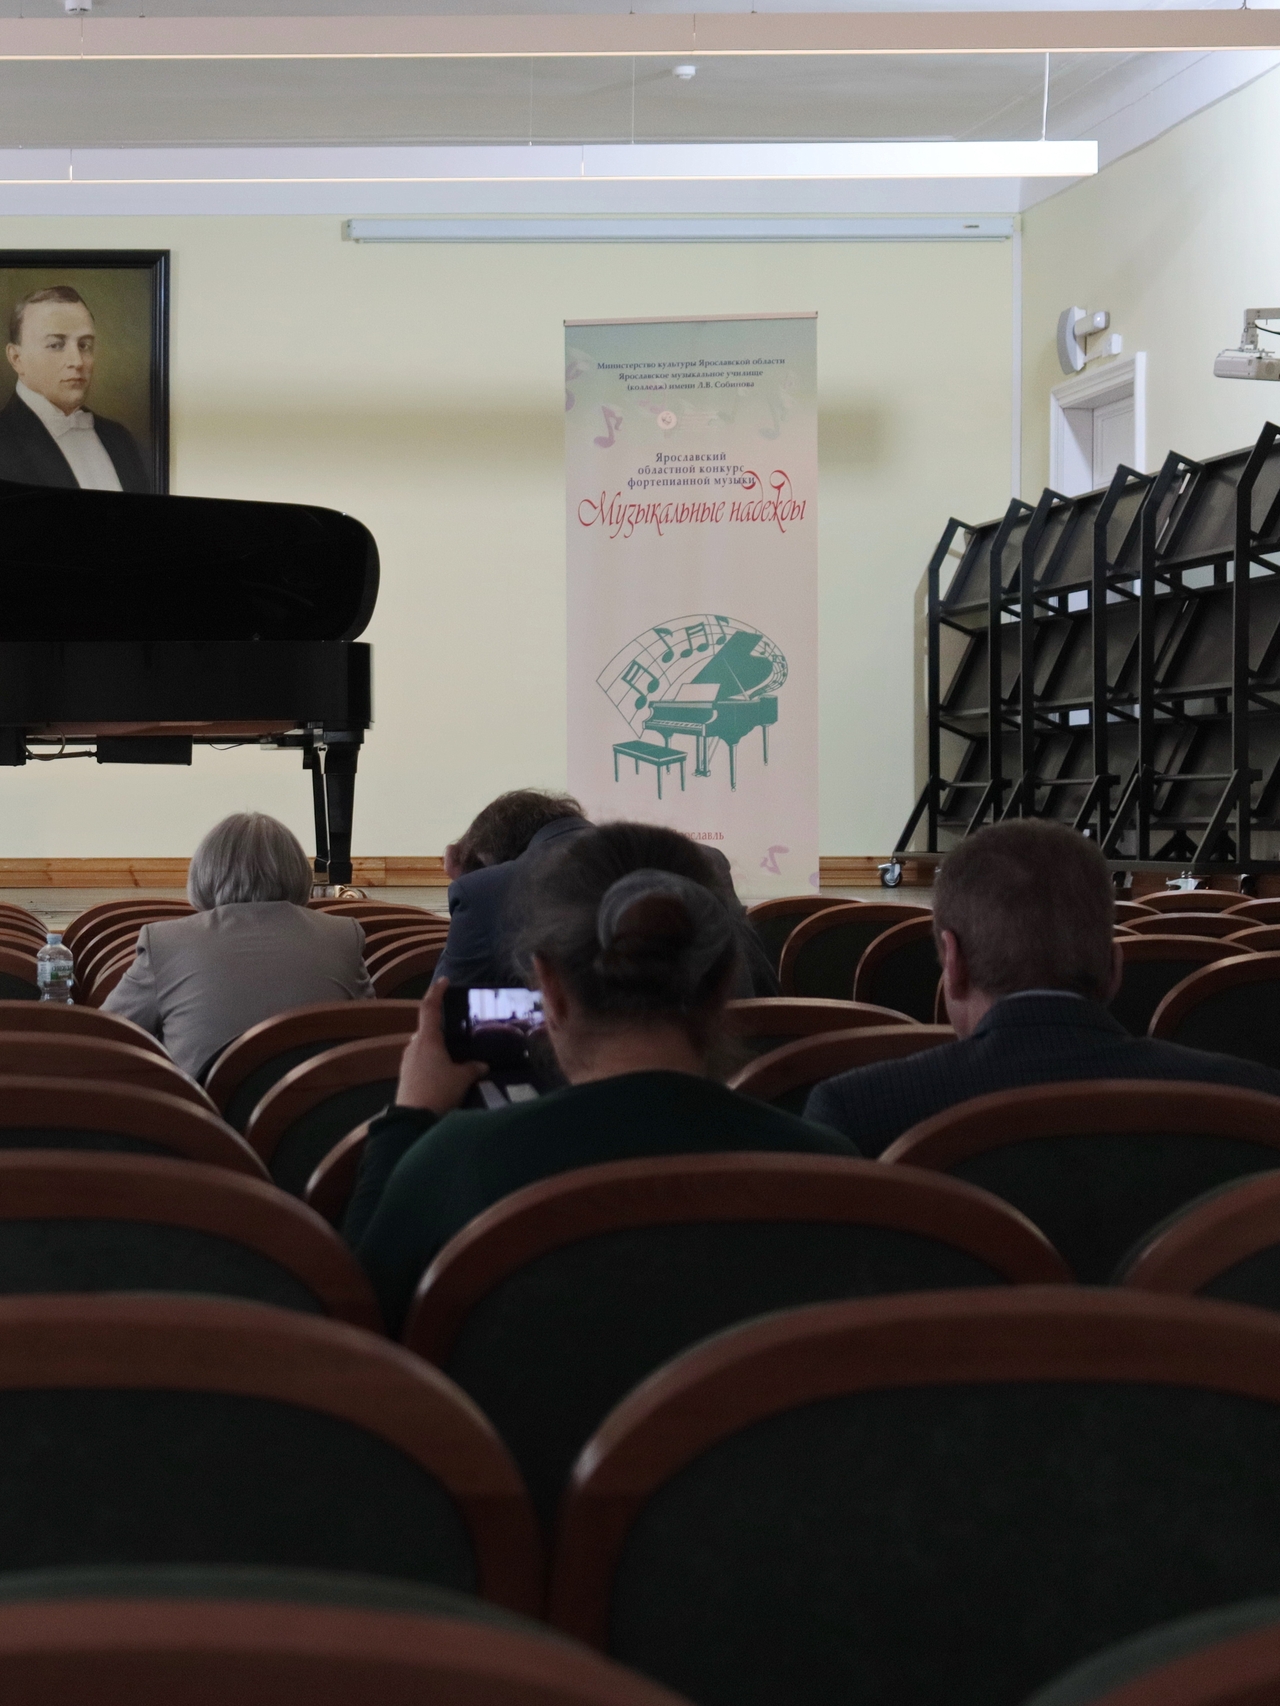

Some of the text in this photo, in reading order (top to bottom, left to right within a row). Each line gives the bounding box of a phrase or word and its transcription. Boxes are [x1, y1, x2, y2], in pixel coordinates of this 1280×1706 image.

[597, 357, 786, 371] Министерство культуры Ярославской области
[618, 369, 764, 381] Ярославское музыкальное училище
[714, 380, 755, 388] Собинова
[655, 452, 727, 464] Ярославский
[637, 464, 745, 475] областной конкурс
[627, 476, 756, 490] фортепианной музыки
[577, 469, 807, 539] Музыкальные надежды
[673, 829, 724, 840] ославль
